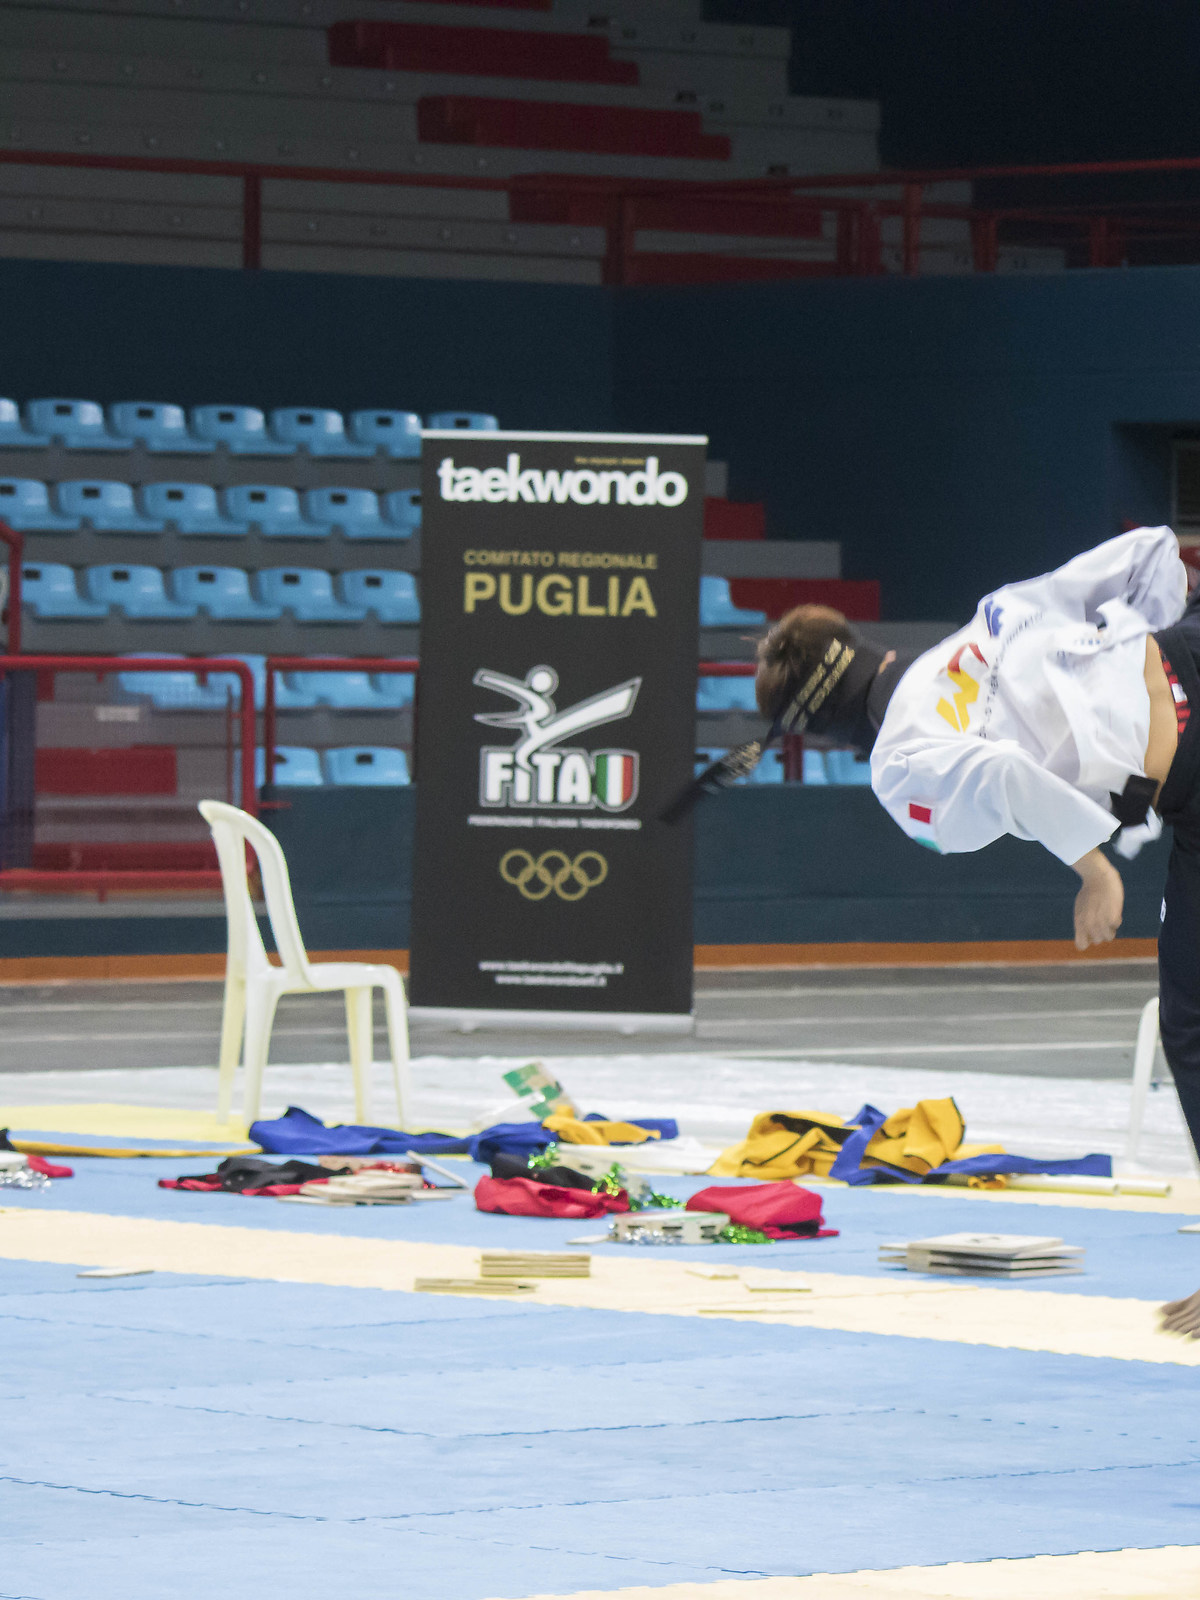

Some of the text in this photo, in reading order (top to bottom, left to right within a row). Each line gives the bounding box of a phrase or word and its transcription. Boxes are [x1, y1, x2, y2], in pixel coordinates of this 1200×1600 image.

[437, 452, 688, 507] taekwondo
[463, 549, 658, 570] COMITATO REGIONALE
[463, 572, 658, 618] PUGLIA
